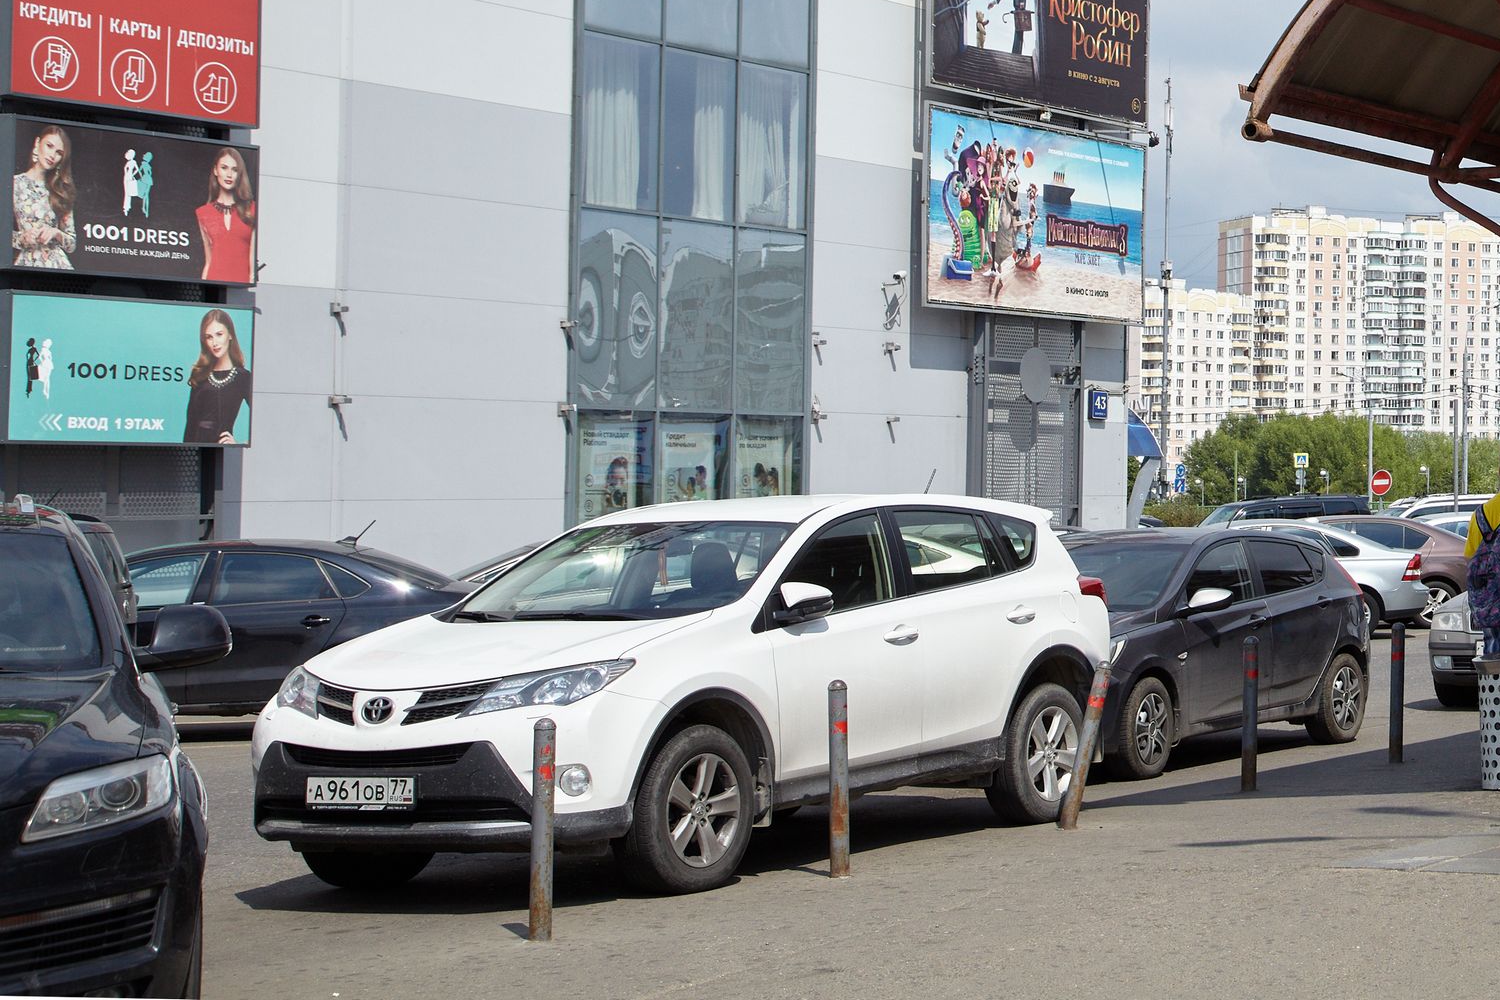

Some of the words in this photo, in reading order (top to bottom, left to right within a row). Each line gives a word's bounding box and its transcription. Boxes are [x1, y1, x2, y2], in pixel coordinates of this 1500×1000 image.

[19, 1, 92, 29] КРЕДИТЫ
[109, 17, 161, 41] КАРТЫ
[176, 28, 254, 56] ДЕПОЗИТЫ
[1071, 20, 1132, 68] Робин
[83, 223, 129, 242] 1001
[133, 227, 190, 247] DRESS
[1119, 226, 1126, 254] 3
[84, 245, 110, 254] НОВОЕ
[111, 246, 138, 256] ПЛАТЬЕ
[139, 249, 171, 258] КАЖДЫЙ
[171, 252, 190, 260] ДЕНЬ
[1070, 287, 1085, 296] КИНО
[67, 362, 117, 380] 1001
[124, 364, 184, 382] DRESS
[1094, 395, 1107, 410] 43
[67, 415, 109, 431] ВХОД
[114, 417, 121, 430] 1
[124, 417, 164, 431] ЭТАЖ
